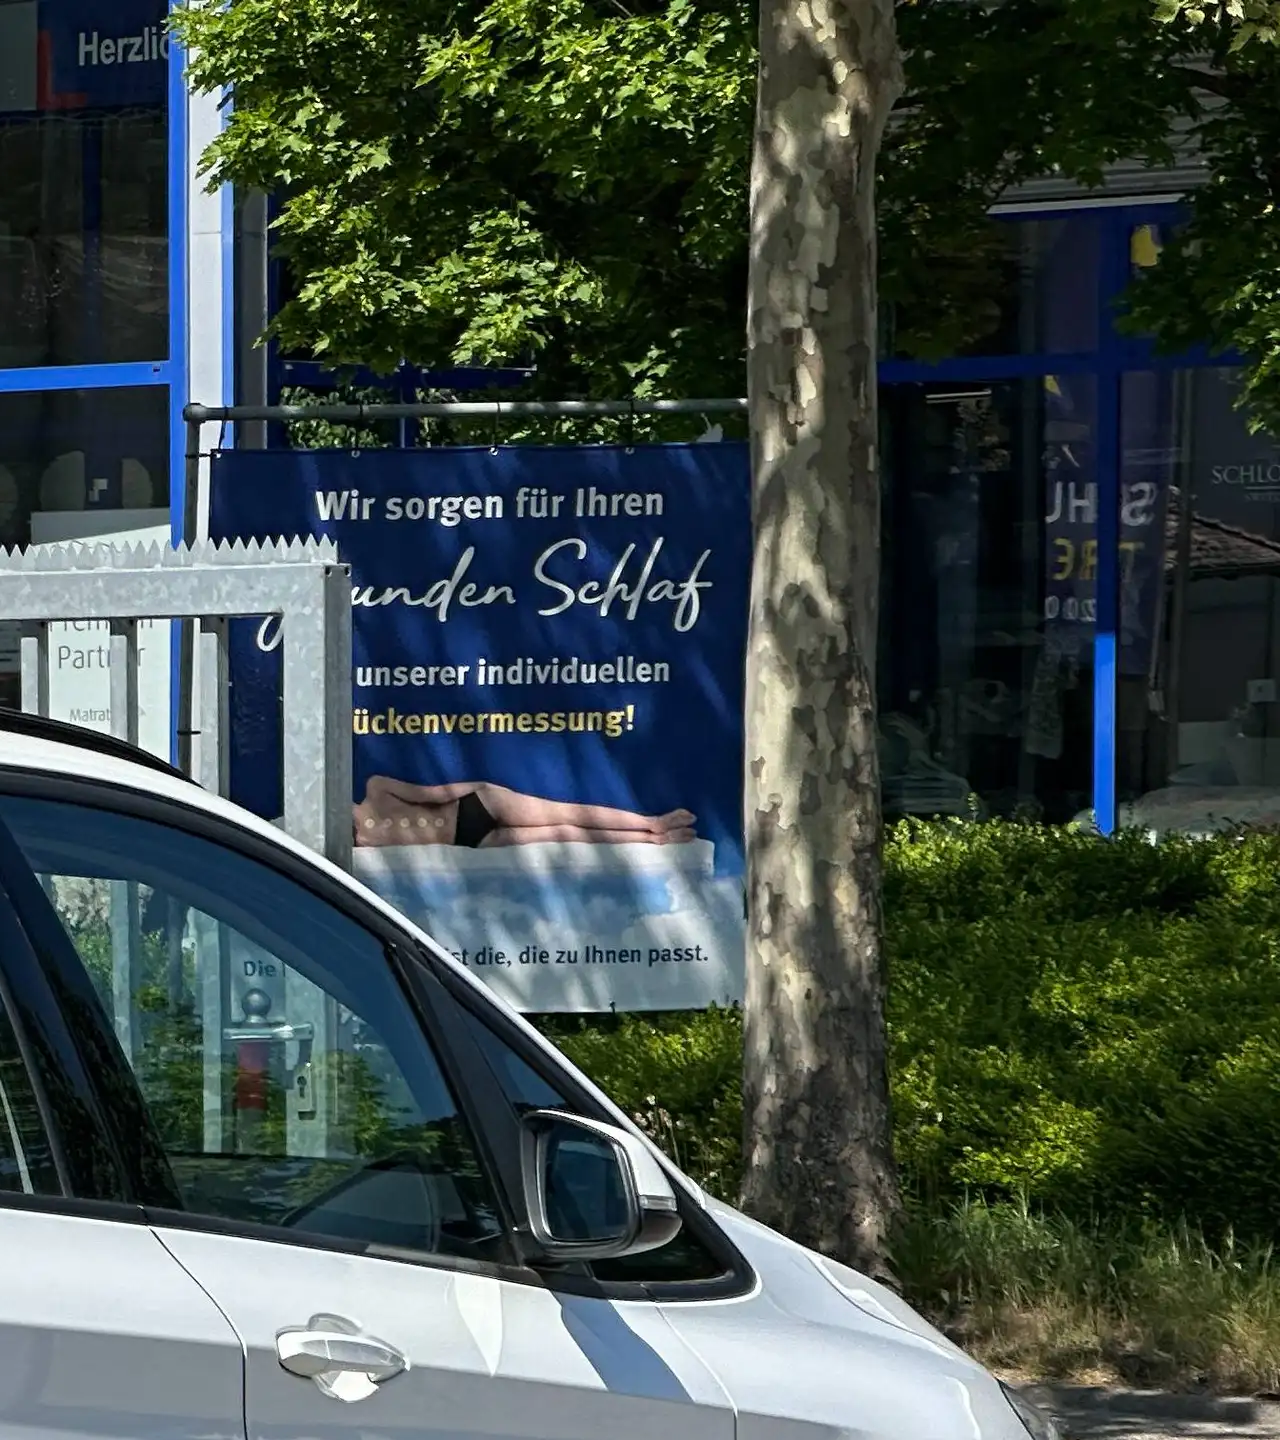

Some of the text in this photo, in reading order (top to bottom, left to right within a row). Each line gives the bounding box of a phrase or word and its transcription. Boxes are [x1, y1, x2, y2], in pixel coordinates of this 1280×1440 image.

[315, 486, 664, 527] Wir sorgen für Ihren
[533, 536, 713, 633] Schlaf
[355, 655, 670, 687] unserer individuellen
[352, 704, 635, 738] ückenvermessung!
[244, 959, 277, 977] Die
[476, 945, 513, 968] die,
[518, 944, 550, 965] die
[555, 948, 578, 964] zu
[584, 944, 641, 964] Ihnen
[648, 943, 708, 968] passt.
